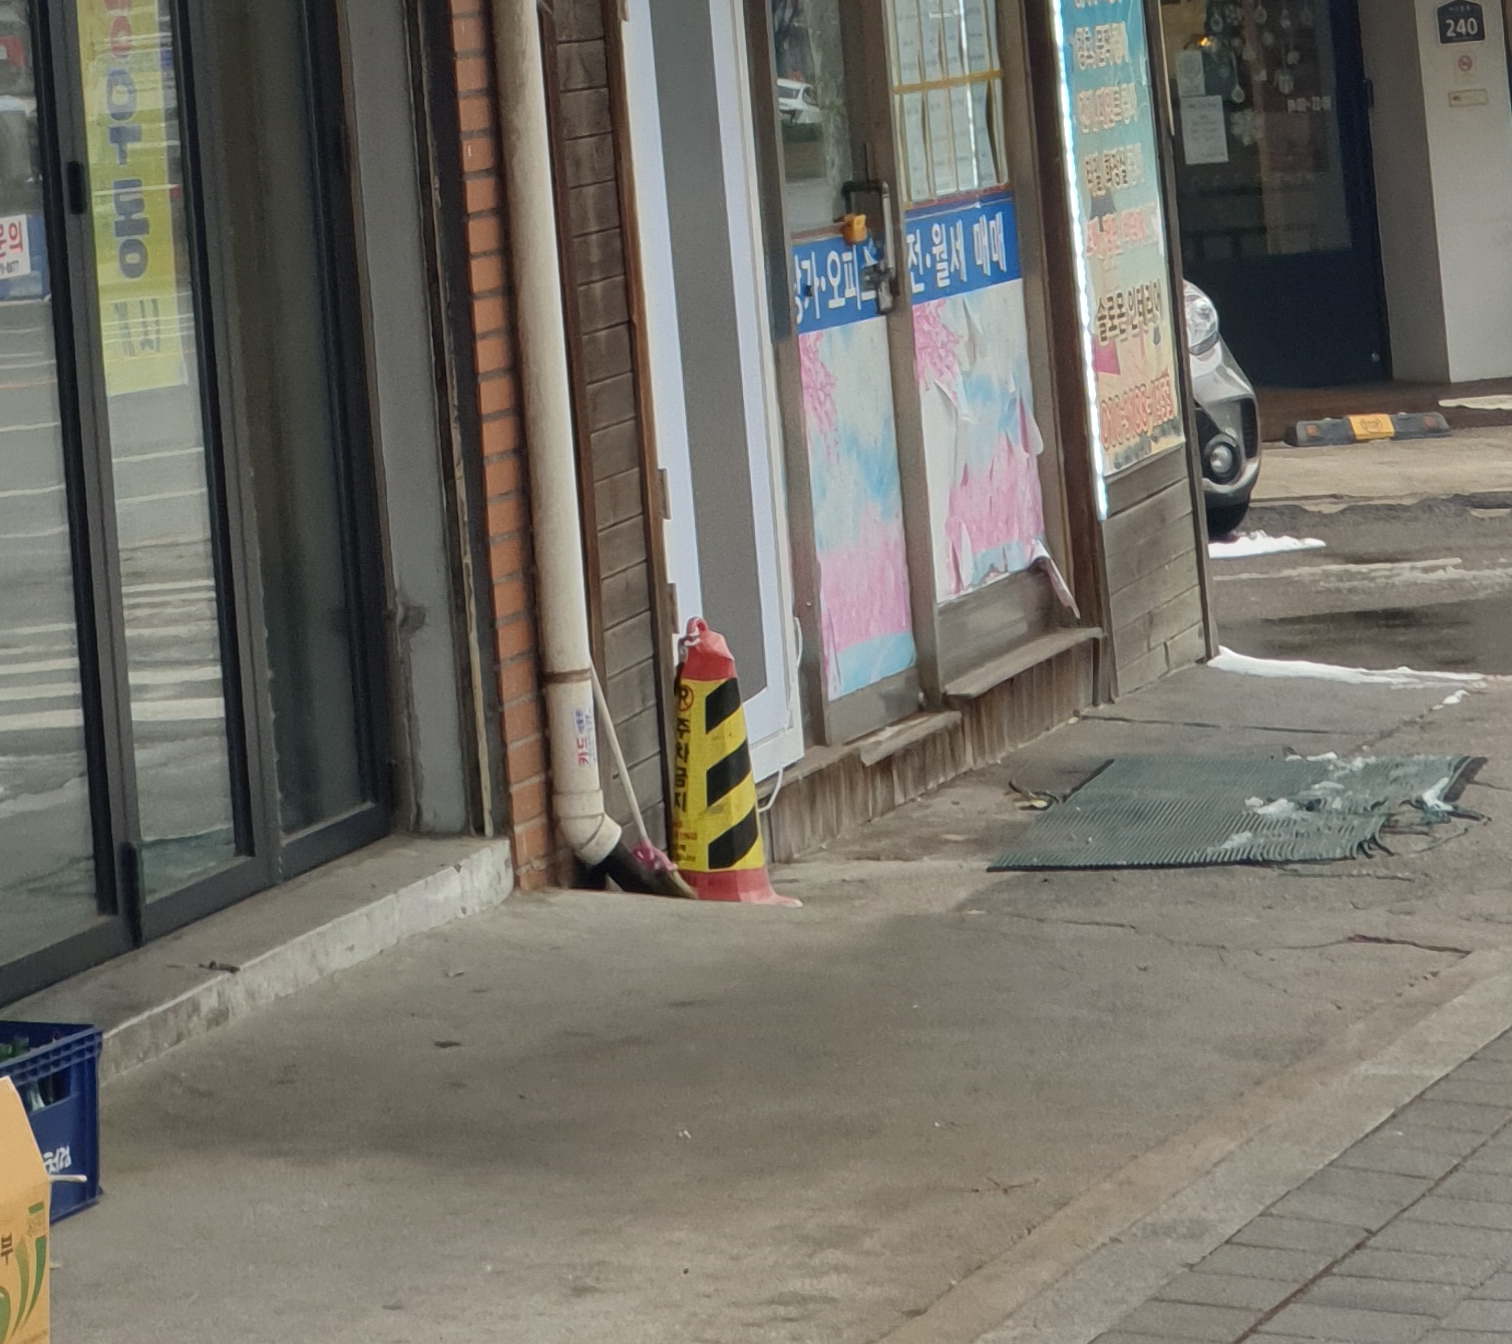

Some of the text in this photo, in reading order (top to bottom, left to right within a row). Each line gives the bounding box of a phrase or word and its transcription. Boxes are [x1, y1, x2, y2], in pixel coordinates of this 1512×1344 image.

[1444, 18, 1479, 38] 240
[972, 211, 1008, 277] 매매
[43, 1145, 73, 1174] 처럼
